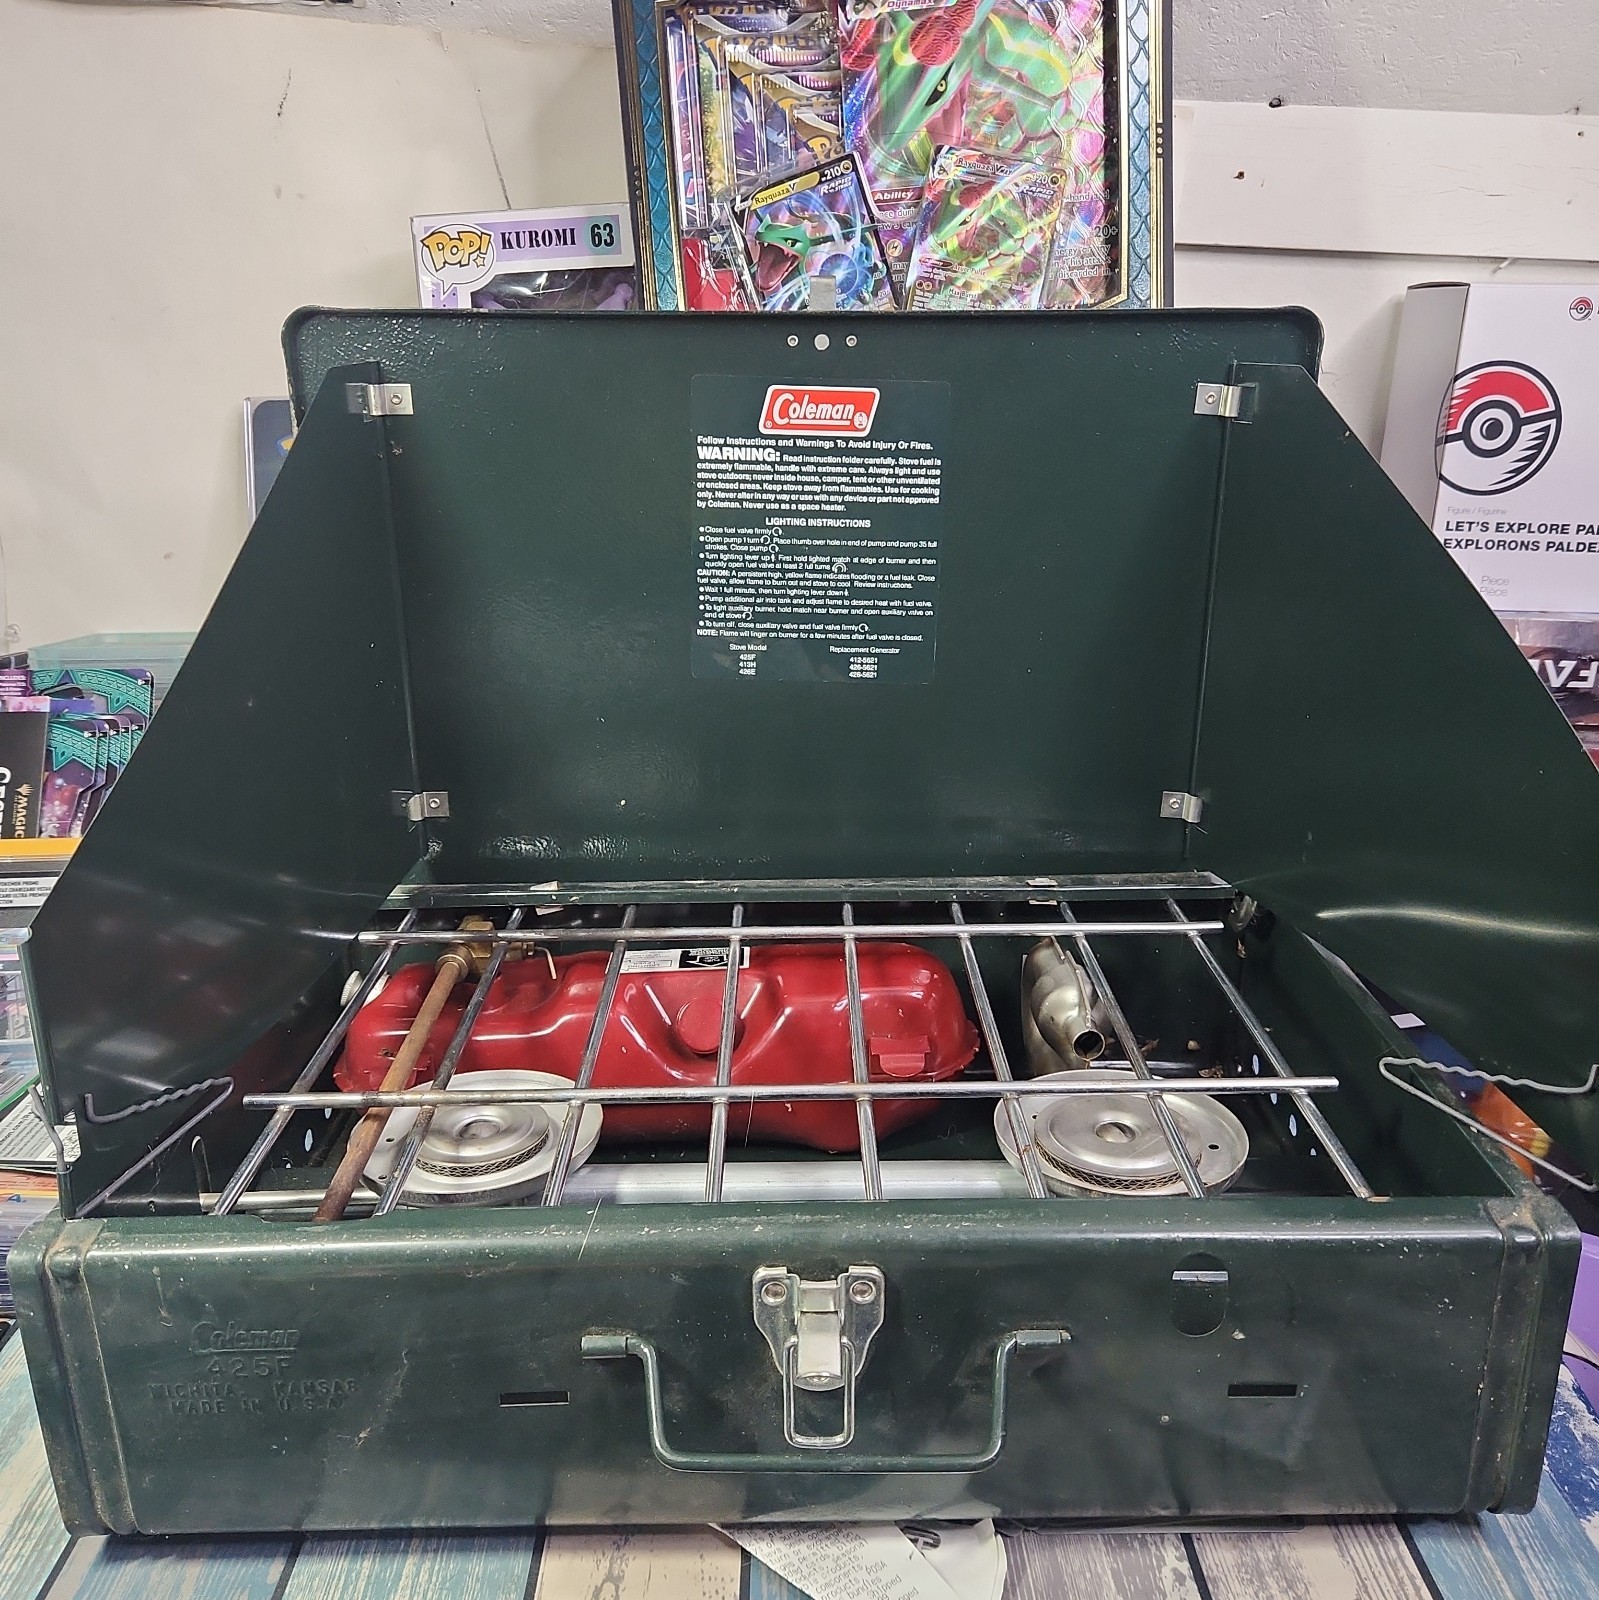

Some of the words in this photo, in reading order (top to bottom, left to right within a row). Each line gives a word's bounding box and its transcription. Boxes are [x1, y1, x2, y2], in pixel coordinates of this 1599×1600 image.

[825, 166, 841, 182] 210
[754, 188, 790, 206] Rayquaza
[874, 190, 915, 201] Ability
[1070, 191, 1090, 202] hand
[590, 222, 616, 248] 63
[1094, 224, 1118, 238] 20+
[500, 227, 577, 250] KUROMI
[420, 229, 492, 273] POP!
[1058, 268, 1098, 279] discarded
[772, 392, 855, 426] Coleman
[697, 436, 725, 444] Follow
[727, 437, 776, 445] Instructions
[778, 438, 794, 446] and
[796, 438, 835, 449] Warnings
[836, 439, 847, 447] To
[848, 440, 871, 448] Avoid
[873, 440, 897, 450] Injury
[898, 441, 910, 449] Or
[910, 441, 933, 449] Fires.
[697, 446, 781, 461] WARNING:
[842, 456, 864, 464] folder
[864, 457, 897, 467] carefully.
[697, 462, 733, 471] extremely
[734, 463, 774, 472] flammable,
[817, 465, 847, 473] extreme
[868, 466, 893, 475] Always
[895, 467, 911, 476] light
[912, 467, 926, 475] and
[697, 471, 717, 479] stove
[717, 472, 752, 481] outdoors;
[774, 473, 797, 481] inside
[797, 474, 821, 483] house,
[852, 475, 868, 483] tent
[896, 476, 941, 484] unventilated
[763, 483, 782, 492] Keep
[803, 485, 821, 493] away
[840, 485, 884, 493] flammables.
[911, 487, 940, 496] cooking
[697, 491, 714, 499] only.
[830, 495, 844, 503] any
[844, 494, 869, 502] device
[877, 495, 892, 504] part
[904, 496, 940, 505] approved
[697, 499, 706, 508] by
[708, 500, 742, 508] Coleman.
[821, 503, 847, 511] heater.
[1448, 507, 1470, 515] Figure
[1478, 507, 1507, 516] Figurine
[766, 518, 807, 526] LIGHTING
[808, 519, 871, 527] INSTRUCTIONS
[1445, 521, 1490, 533] LET'S
[1495, 522, 1570, 535] EXPLORE
[755, 527, 771, 537] firmly
[1443, 538, 1540, 553] EXPLORONS
[1545, 541, 1599, 554] PALDE
[1482, 576, 1510, 586] Piece
[740, 653, 756, 661] 425F
[830, 646, 870, 655] Replacement
[871, 647, 900, 655] Generator
[739, 661, 757, 669] 413H
[14, 795, 28, 838] MAGIC
[190, 1320, 300, 1353] Coleman
[206, 1355, 293, 1377] 425F
[272, 1377, 359, 1398] KANSAS
[169, 1399, 227, 1415] MADE
[242, 1398, 264, 1413] IN
[865, 1560, 888, 1576] POSA
